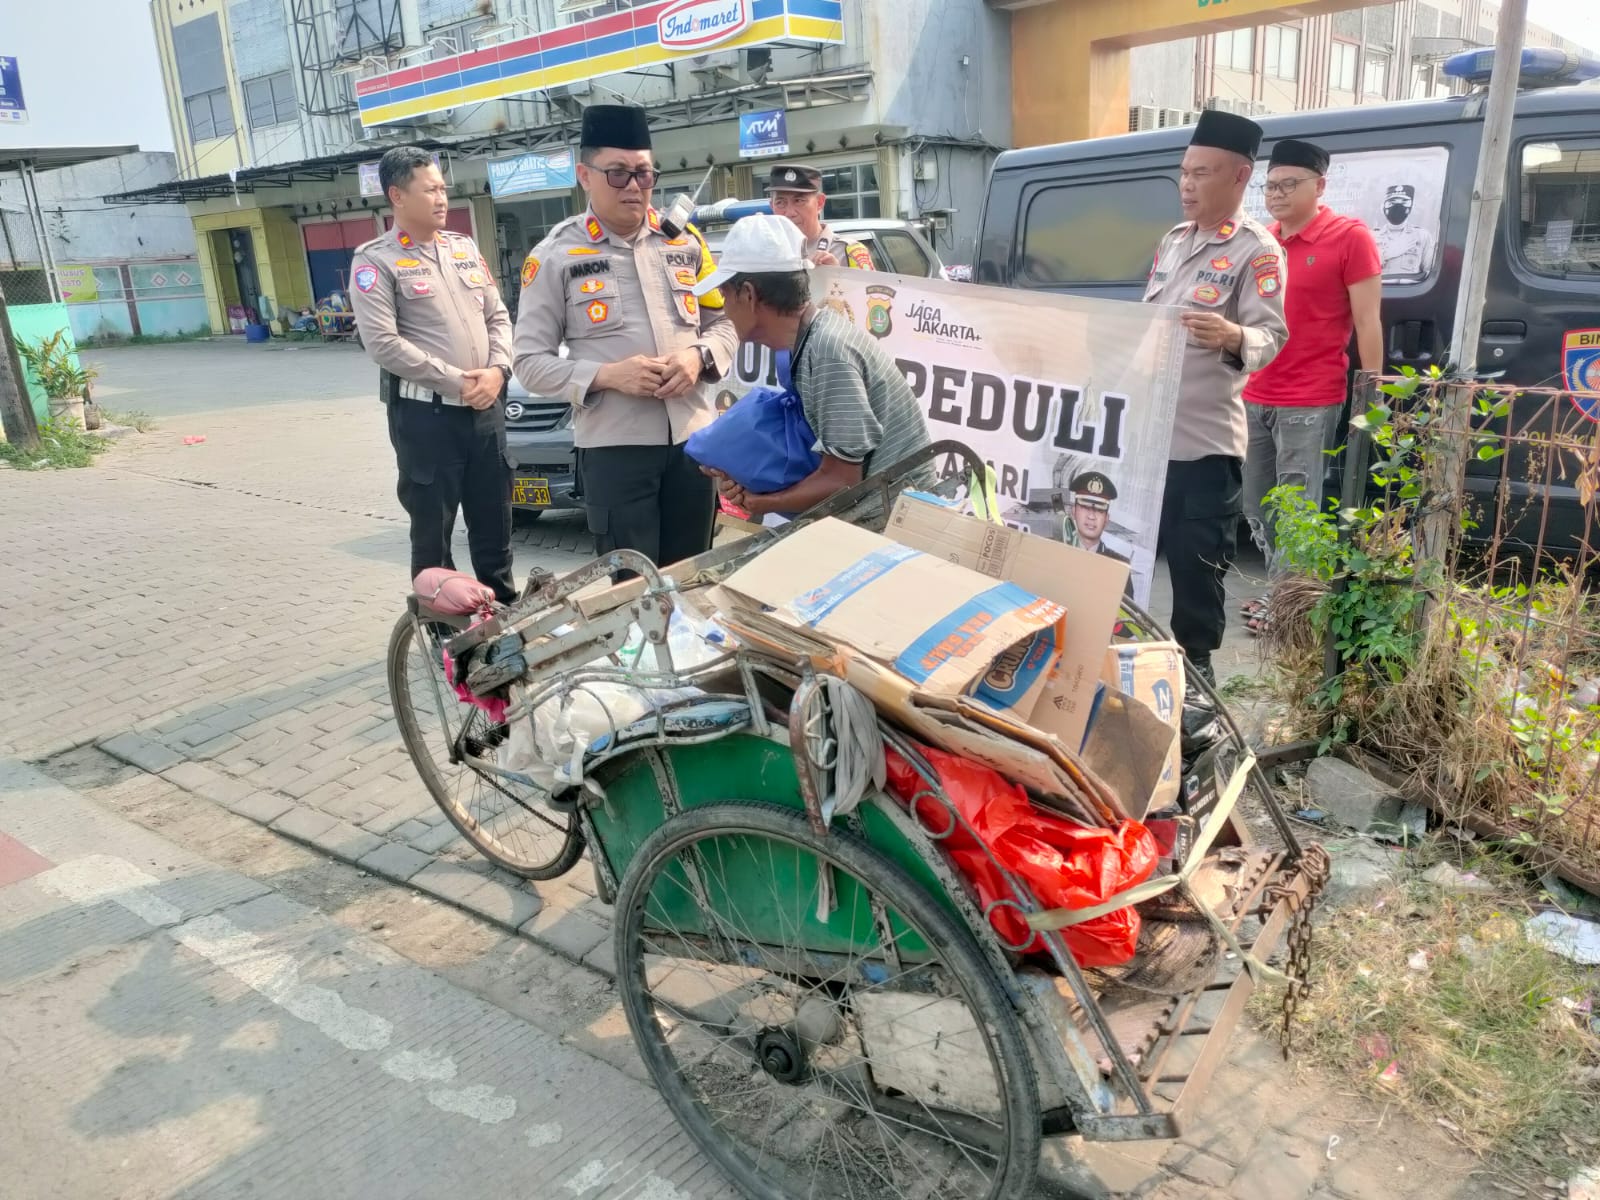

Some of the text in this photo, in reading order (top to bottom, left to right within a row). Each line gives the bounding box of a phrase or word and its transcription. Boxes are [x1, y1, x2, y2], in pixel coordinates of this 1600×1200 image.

[664, 7, 739, 39] Indomaret
[569, 259, 611, 279] IMRON
[1195, 270, 1237, 288] POLRI
[905, 300, 942, 323] JAGA
[1189, 794, 1210, 817] CYLINDER
